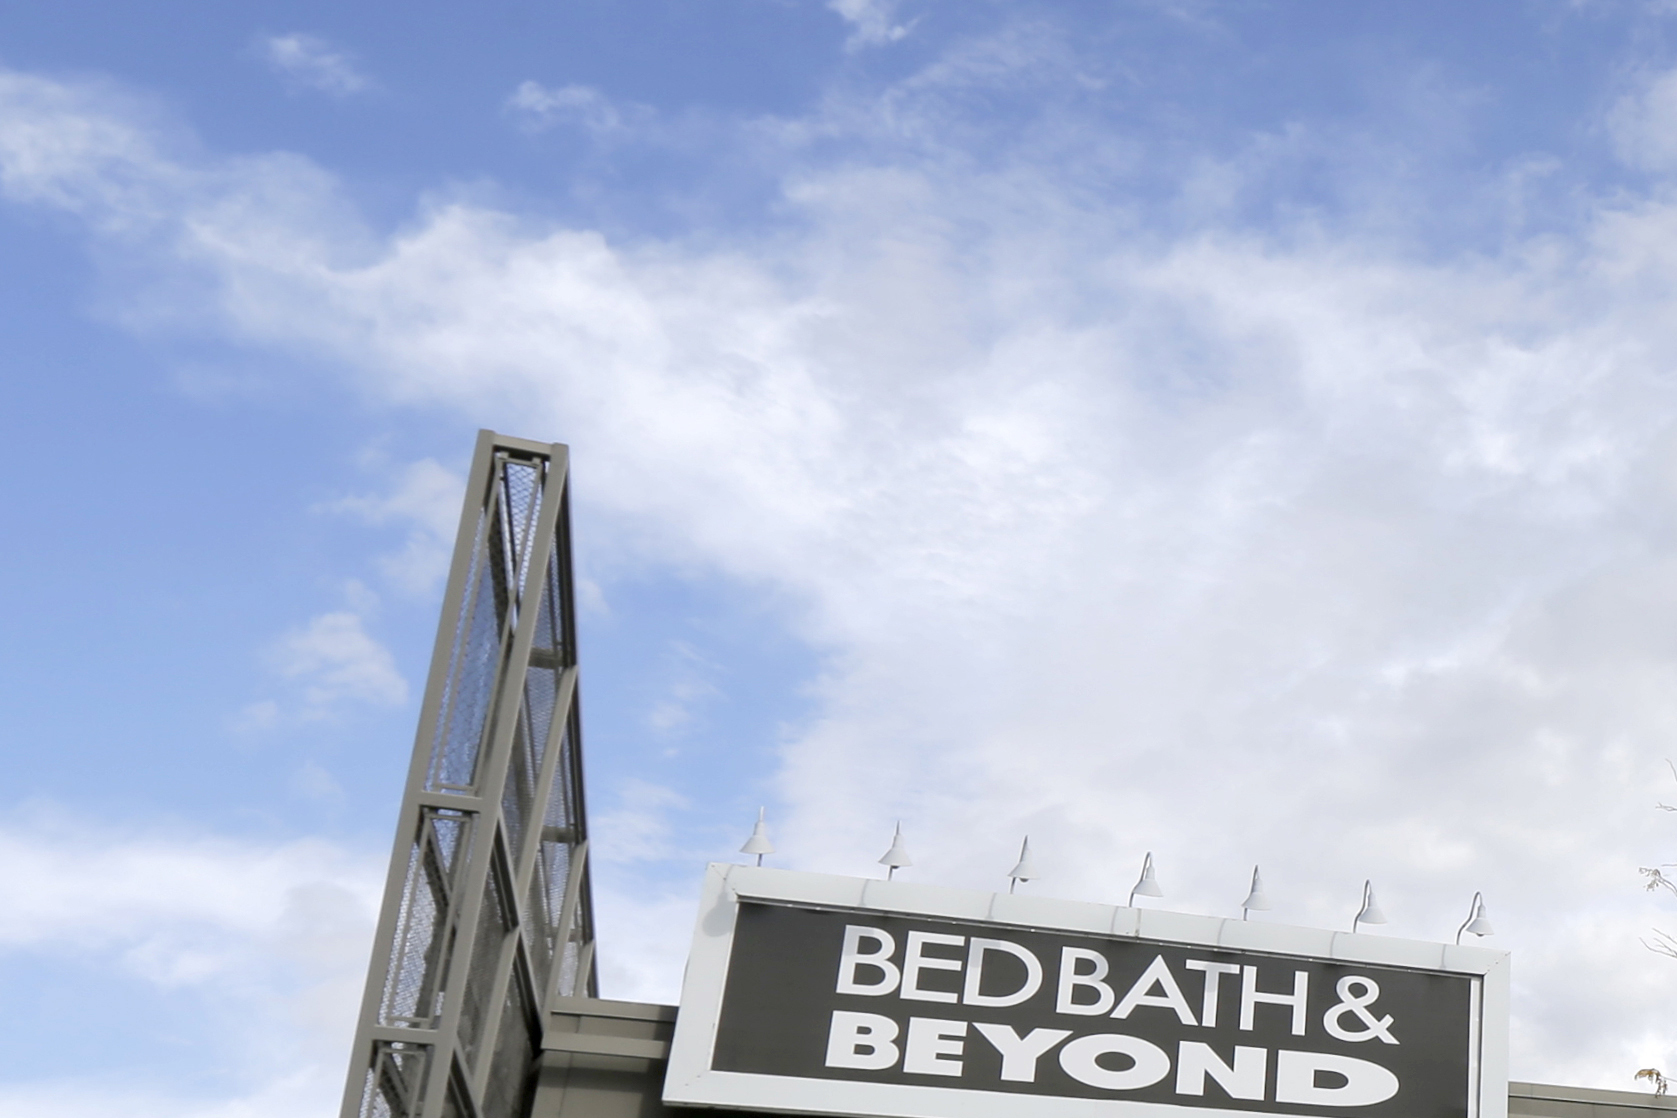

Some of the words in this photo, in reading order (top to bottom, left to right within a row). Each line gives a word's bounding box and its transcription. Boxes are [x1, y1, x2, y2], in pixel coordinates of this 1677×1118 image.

[836, 925, 1042, 1007] BED
[1056, 946, 1308, 1036] BATH
[1323, 975, 1400, 1045] &
[825, 1010, 1400, 1107] BEYOND
